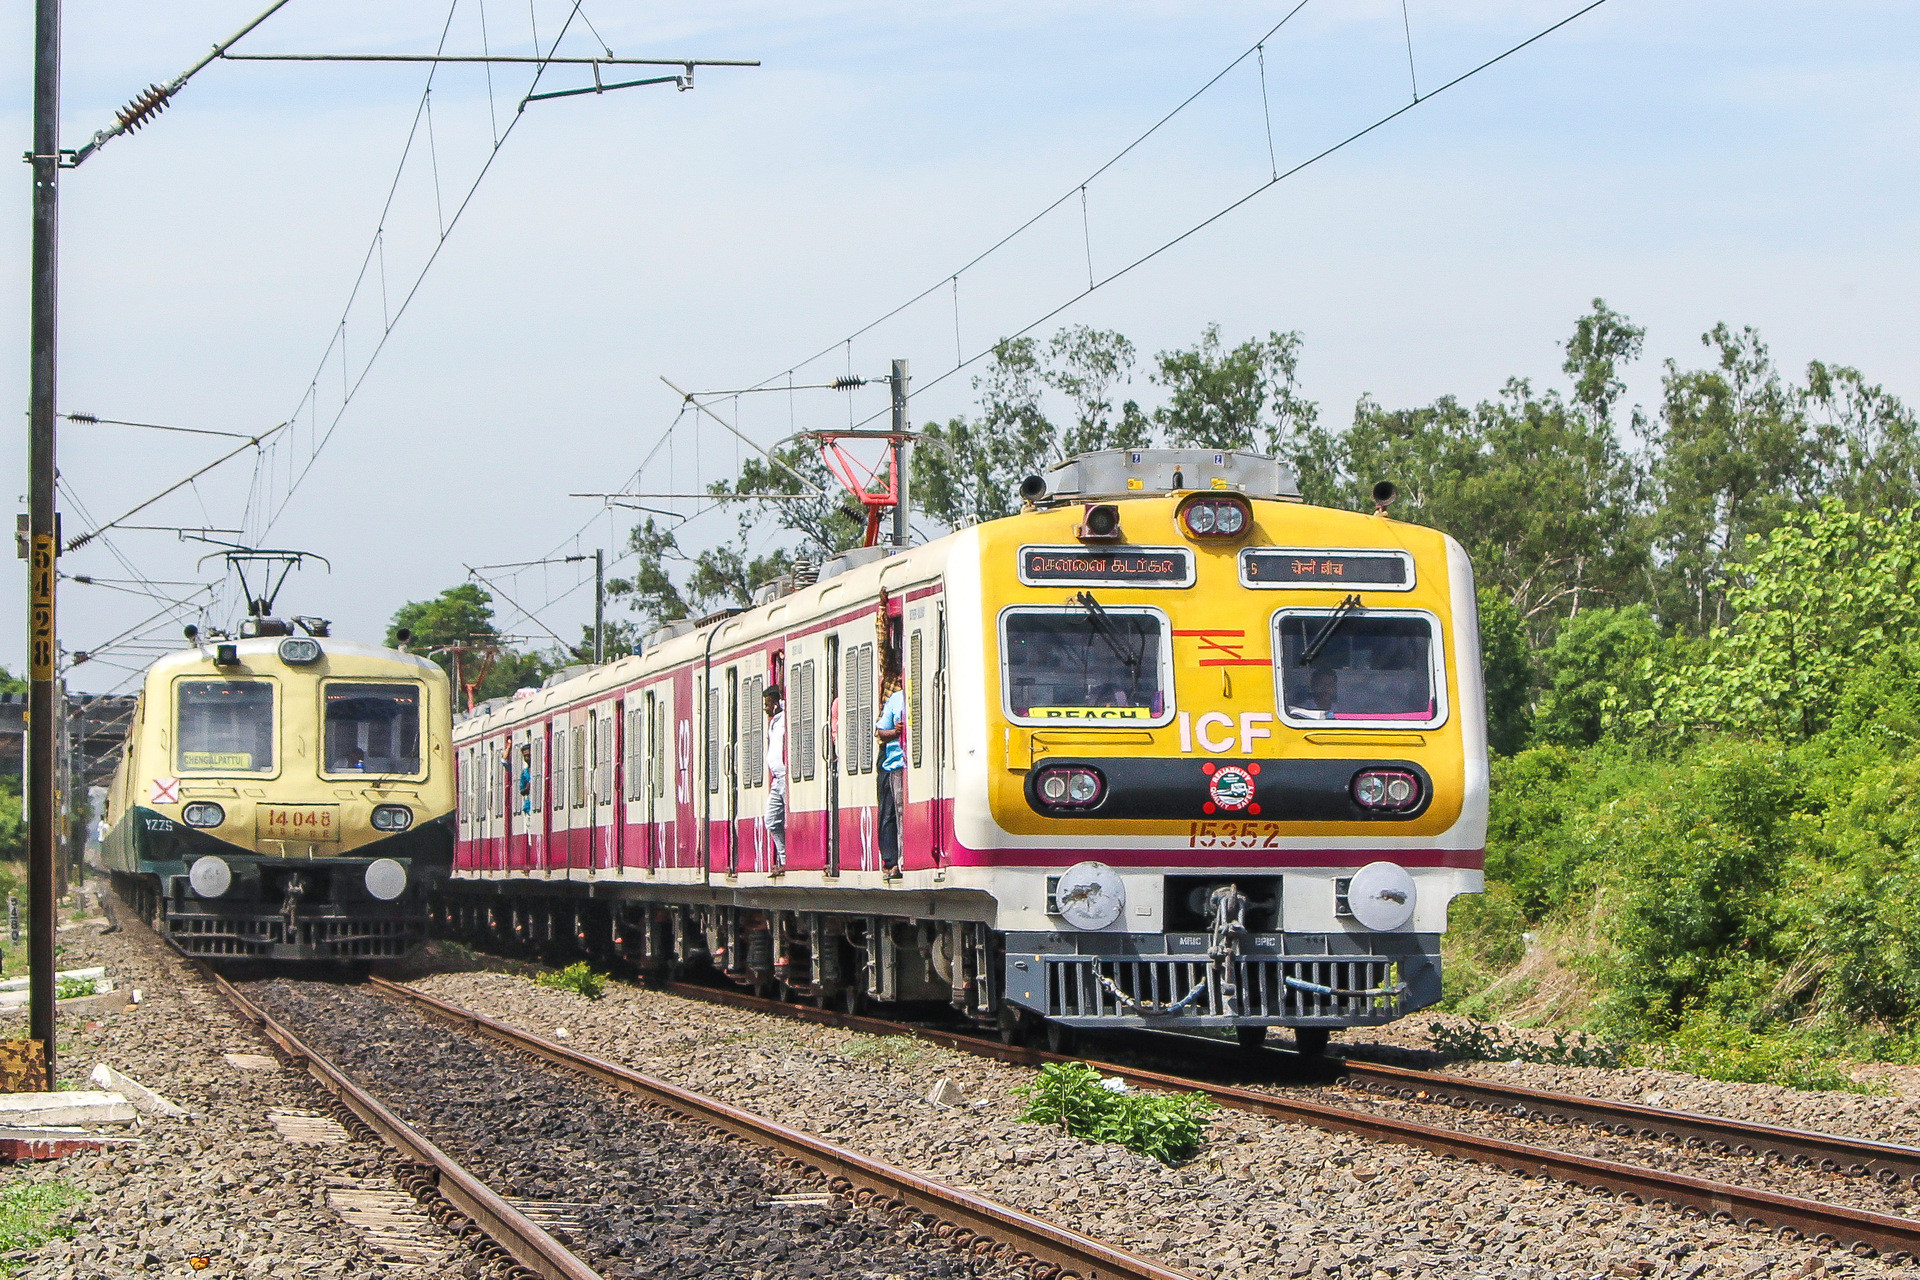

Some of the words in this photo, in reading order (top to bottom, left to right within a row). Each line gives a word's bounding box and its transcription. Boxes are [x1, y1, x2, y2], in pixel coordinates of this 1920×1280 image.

[1178, 710, 1273, 754] ICF
[1211, 766, 1252, 784] RELIABILITY
[1210, 786, 1230, 810] QUALITY
[1236, 785, 1255, 810] SAFETY
[145, 818, 173, 832] YZZS
[268, 809, 331, 827] 14048
[1189, 822, 1280, 848] 15352
